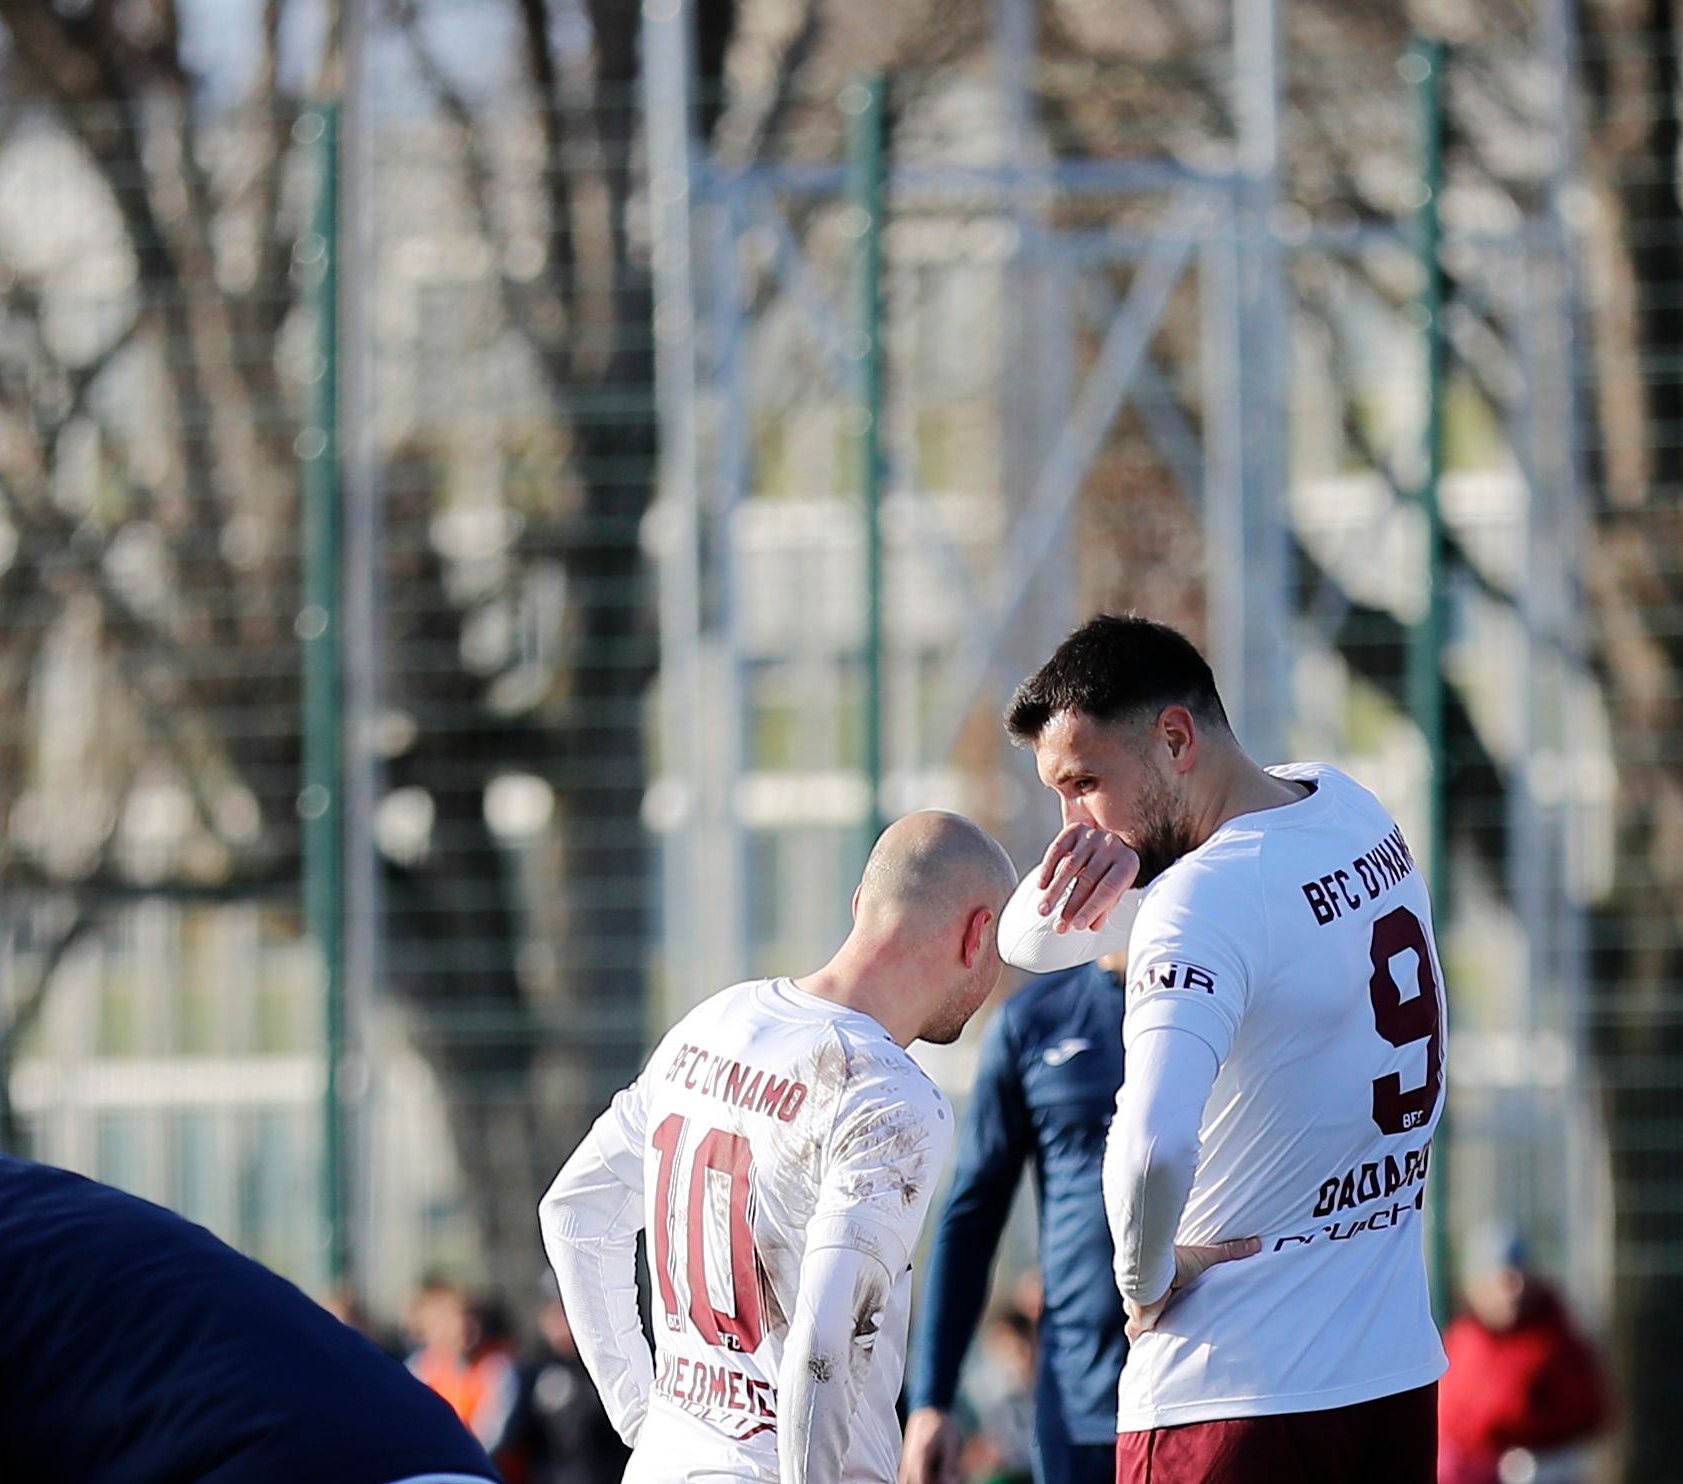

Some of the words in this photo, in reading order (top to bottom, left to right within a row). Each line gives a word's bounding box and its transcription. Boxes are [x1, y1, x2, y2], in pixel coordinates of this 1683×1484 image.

[1301, 869, 1361, 926] BFC
[1353, 823, 1415, 901] DYNA
[1369, 905, 1441, 1135] 9
[651, 1112, 763, 1356] 10
